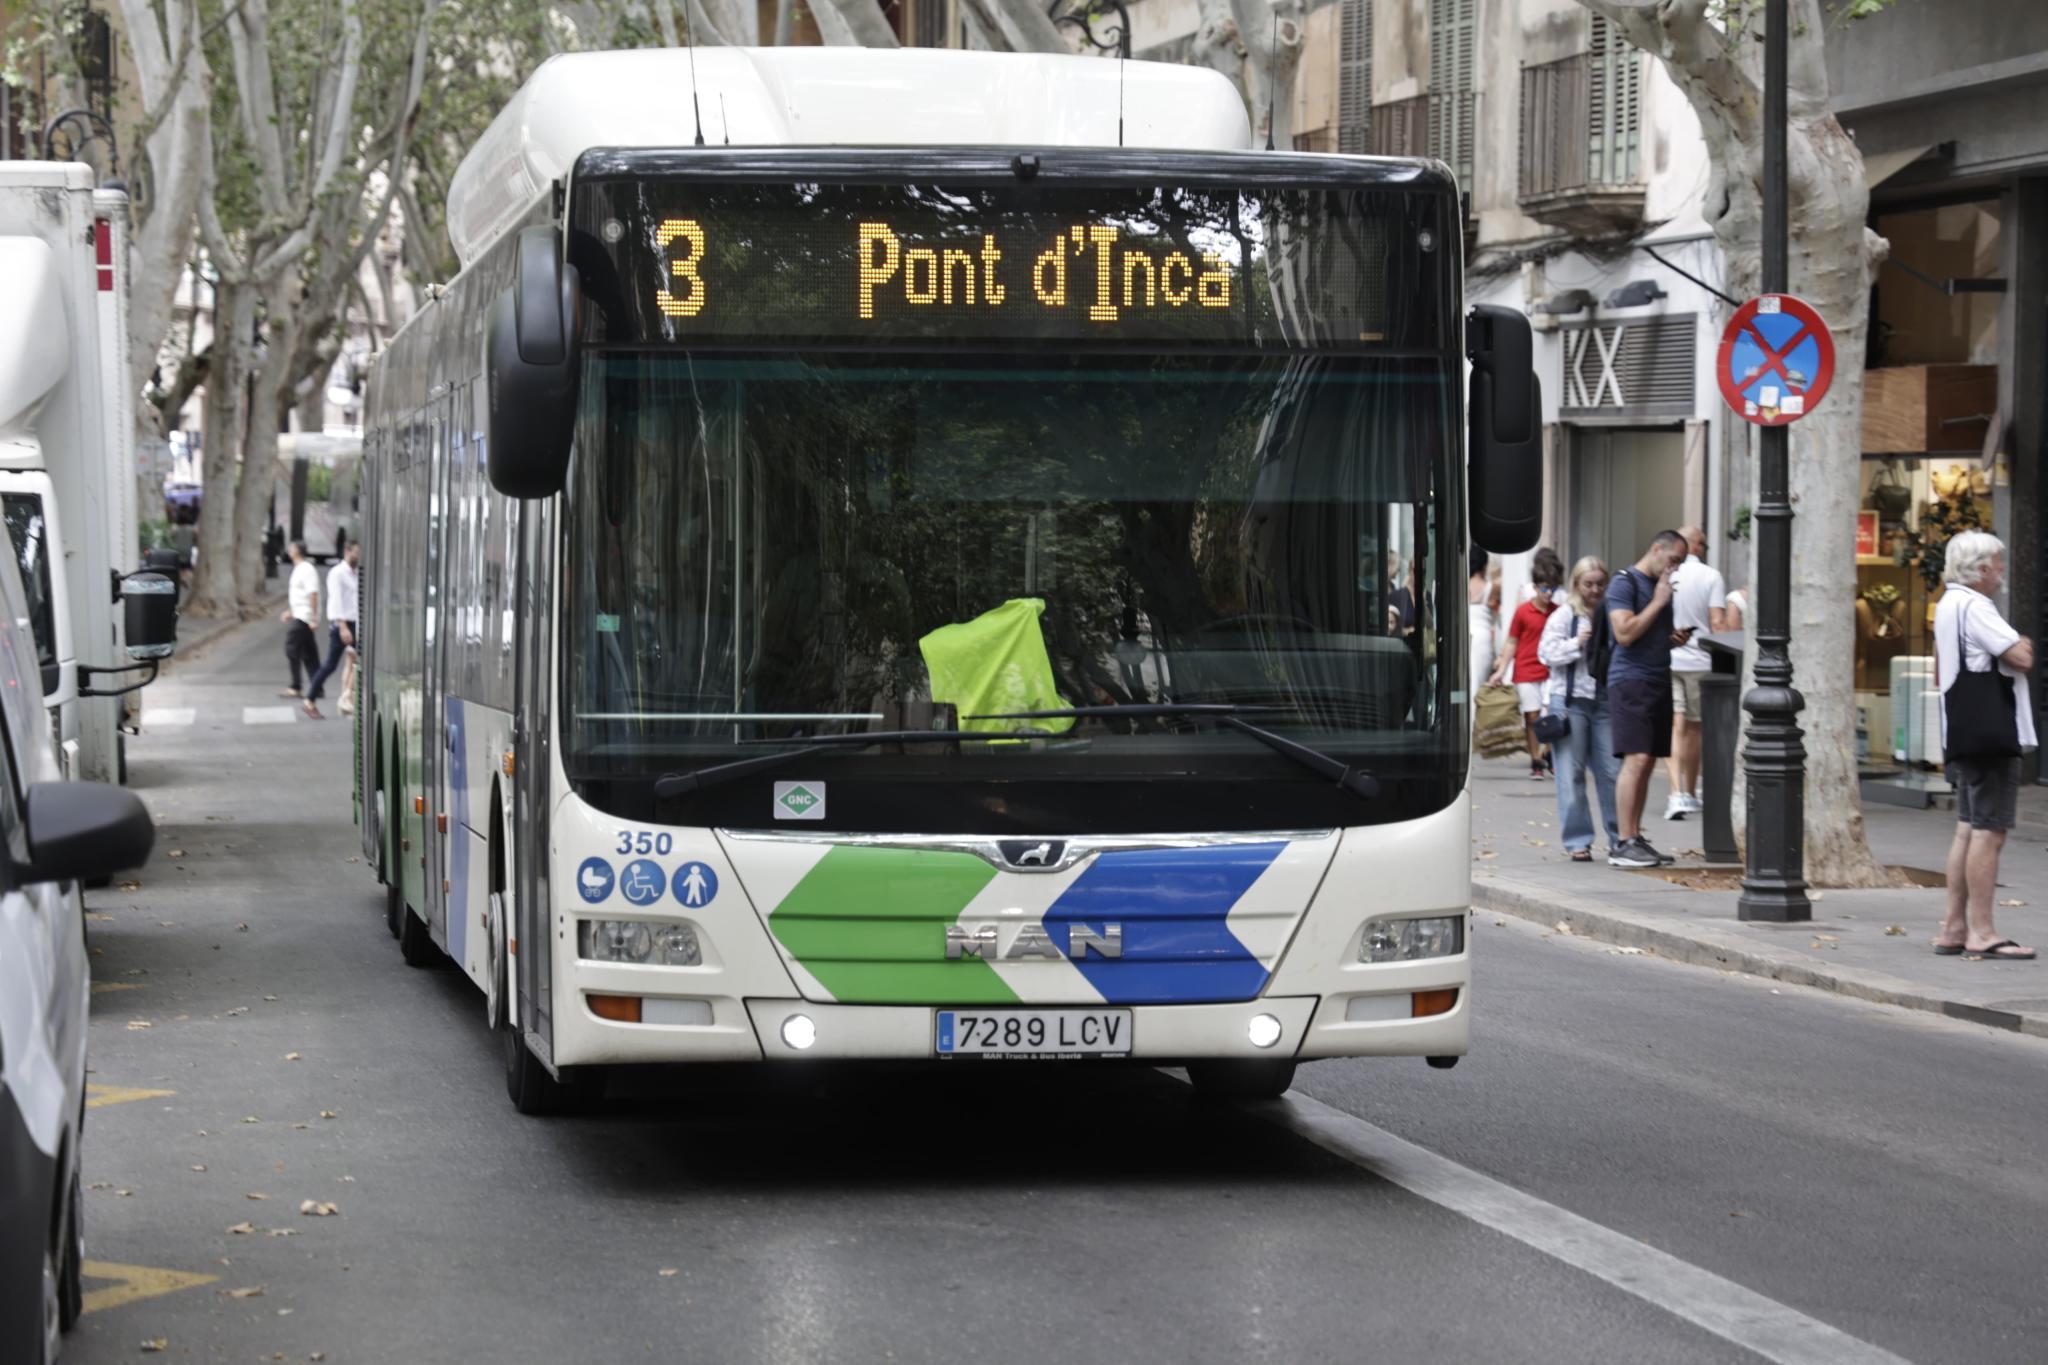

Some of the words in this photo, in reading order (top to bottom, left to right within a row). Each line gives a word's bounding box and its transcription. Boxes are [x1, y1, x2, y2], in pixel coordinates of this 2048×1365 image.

[656, 219, 705, 317] 3
[859, 222, 1006, 319] Pont
[1033, 225, 1231, 321] d'Inca
[787, 794, 812, 806] GNC
[615, 830, 673, 856] 350
[944, 922, 1122, 959] MAN
[942, 1035, 950, 1045] E
[959, 1017, 1046, 1048] 7289
[1059, 1015, 1121, 1046] LCV
[982, 1052, 1002, 1060] MAN
[1005, 1052, 1030, 1060] Truck
[1039, 1052, 1056, 1060] Bus
